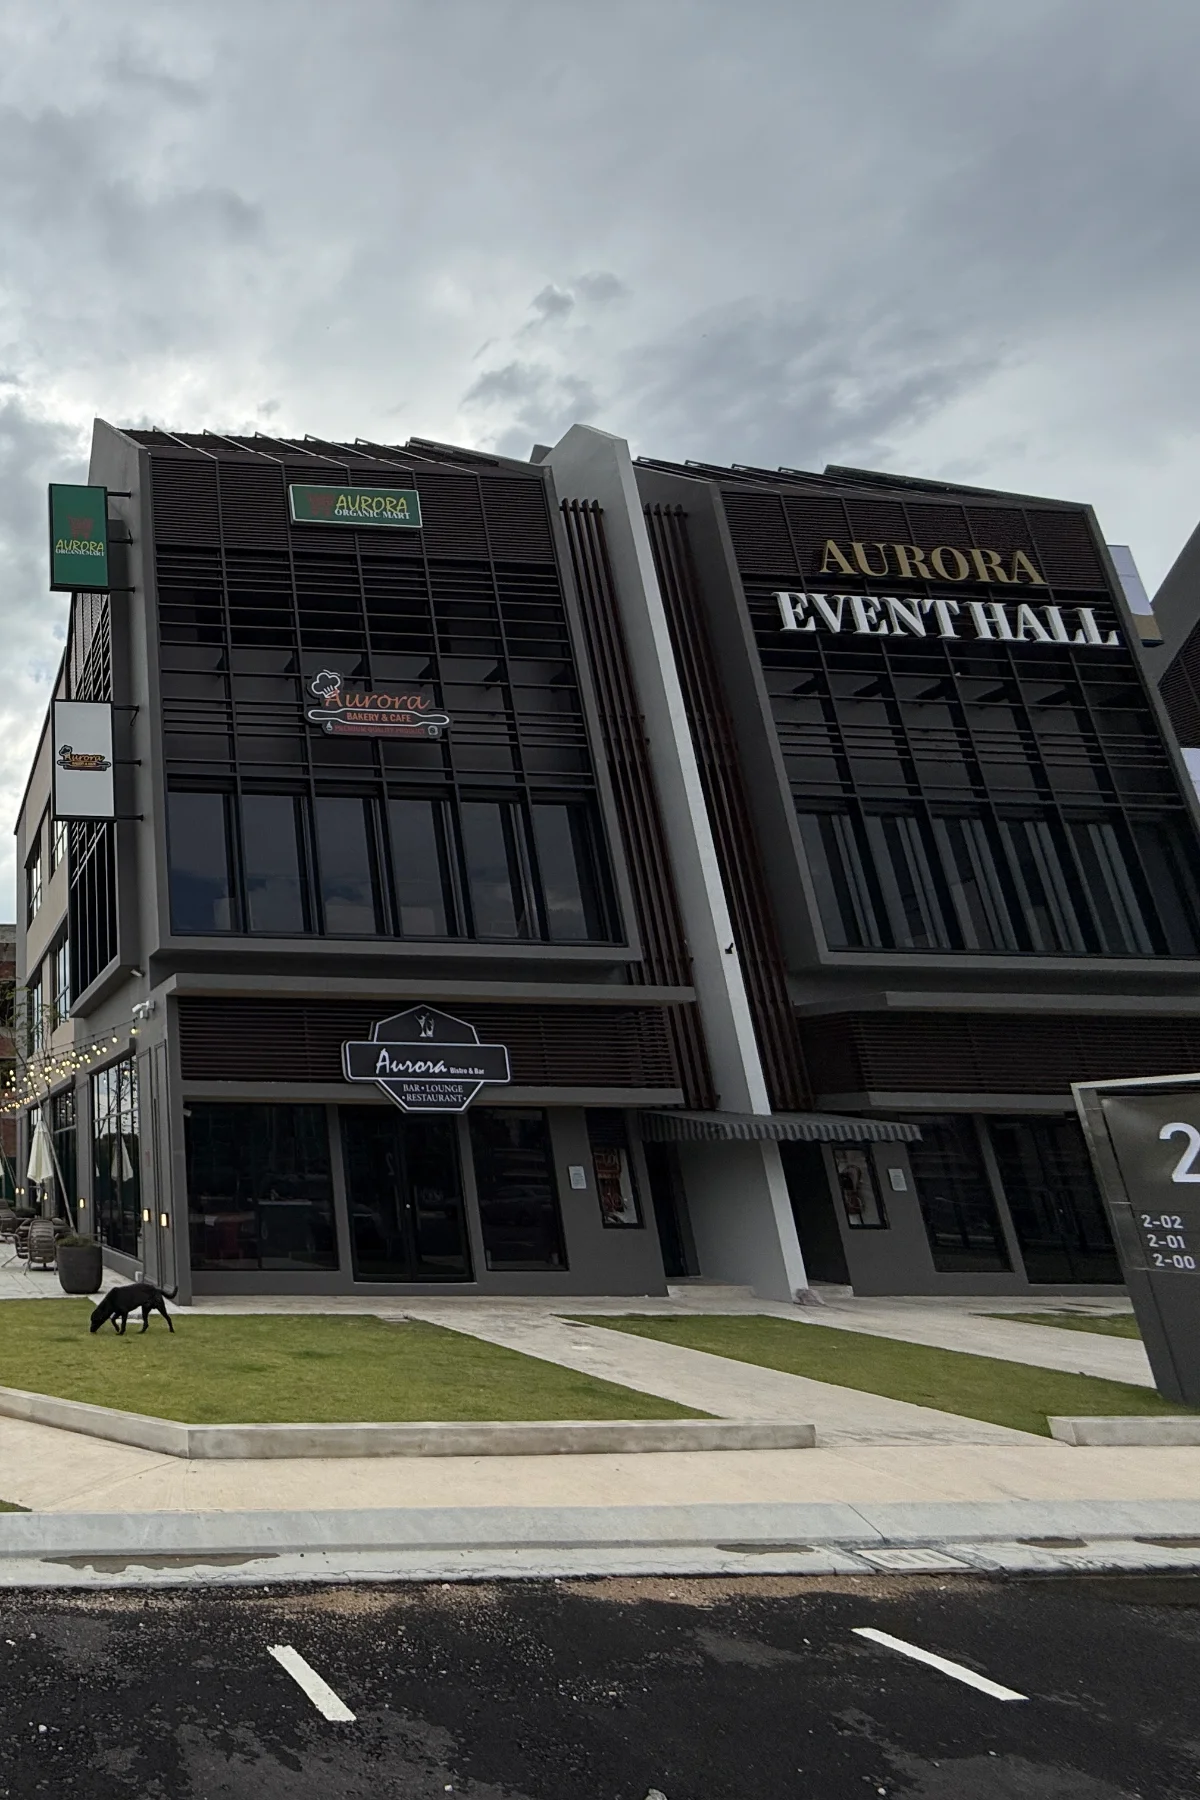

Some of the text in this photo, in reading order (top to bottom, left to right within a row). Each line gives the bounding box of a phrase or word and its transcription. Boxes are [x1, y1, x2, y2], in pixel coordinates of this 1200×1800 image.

[335, 494, 408, 514] AURORA
[334, 508, 411, 519] ORGANIC MART
[55, 539, 104, 552] AURORA
[819, 540, 1048, 585] AURORA
[771, 591, 1120, 646] EVENT HALL
[325, 688, 431, 710] Aurora
[346, 712, 379, 721] BAKERY
[390, 714, 412, 722] CAFE
[376, 1048, 447, 1074] Aurora
[403, 1083, 464, 1093] BAR LOUNGE
[406, 1093, 463, 1102] RESTAURANT
[1159, 1122, 1200, 1183] 2
[1141, 1214, 1184, 1229] 2-02
[1147, 1234, 1186, 1249] 2-01
[1153, 1253, 1196, 1269] 2-00
